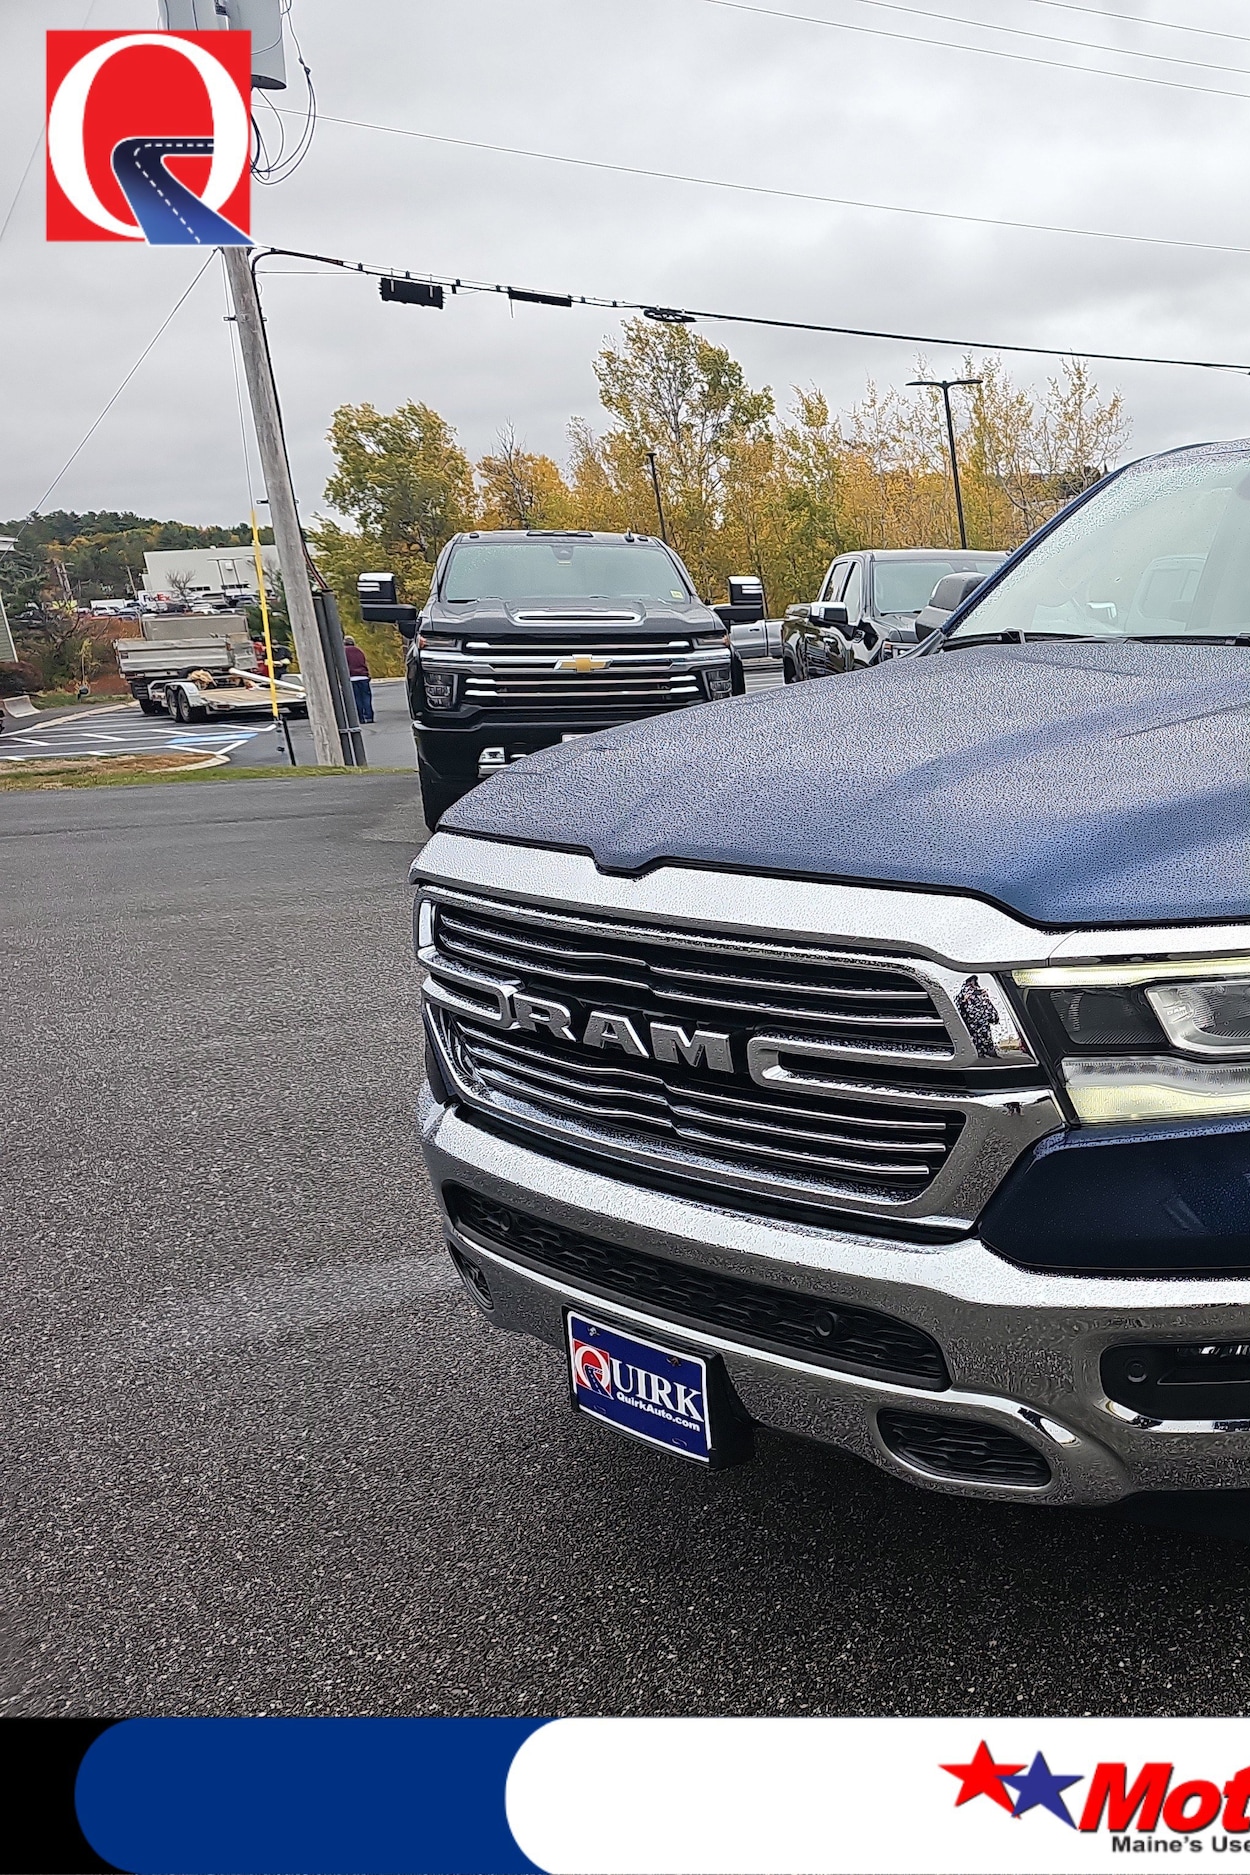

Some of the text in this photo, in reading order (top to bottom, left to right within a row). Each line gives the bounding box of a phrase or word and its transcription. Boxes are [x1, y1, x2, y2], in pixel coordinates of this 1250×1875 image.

[513, 993, 735, 1074] RAM
[575, 1346, 705, 1423] QUIRK
[616, 1391, 701, 1433] QuirkAuto.com
